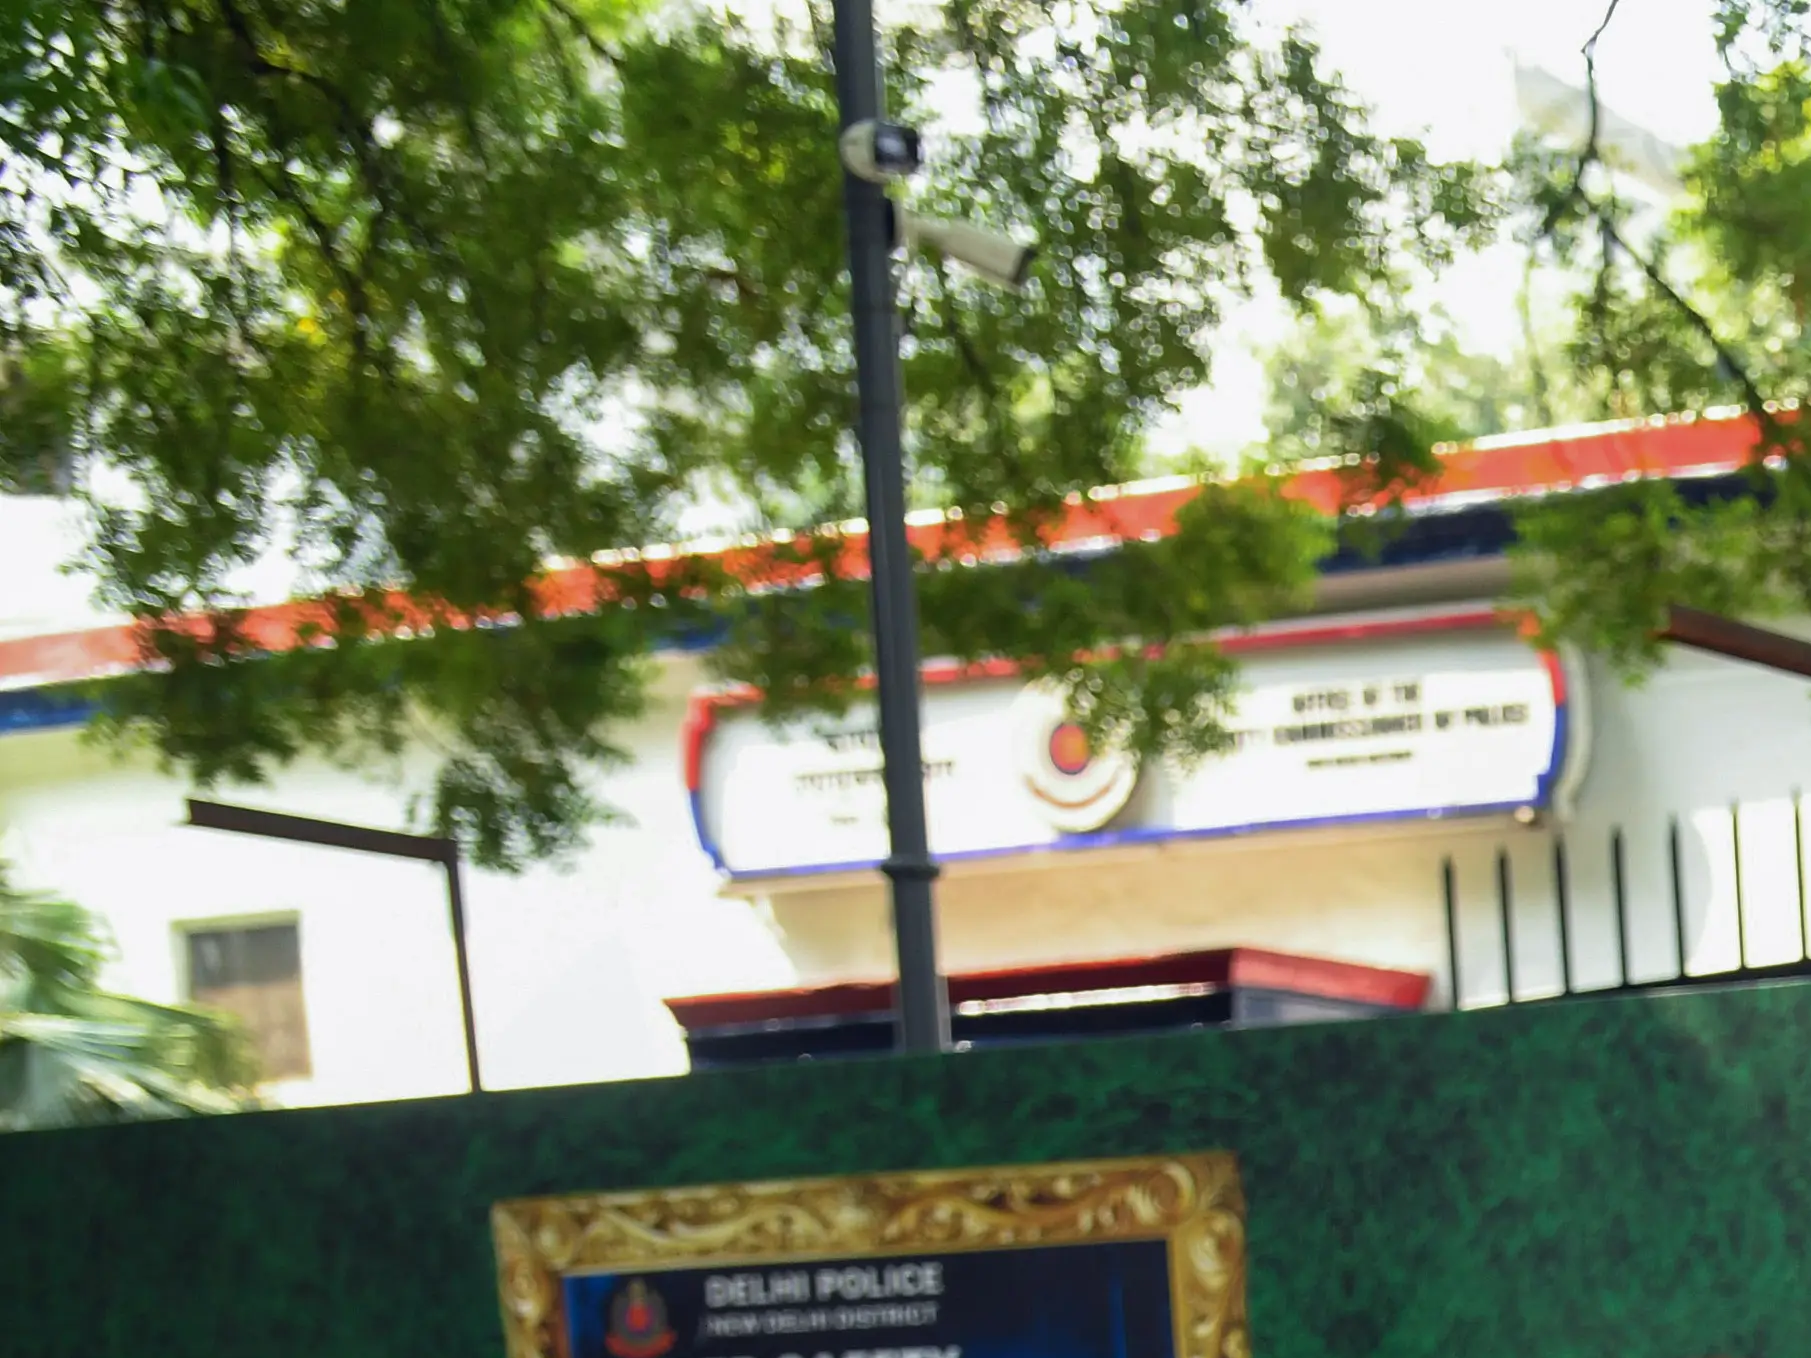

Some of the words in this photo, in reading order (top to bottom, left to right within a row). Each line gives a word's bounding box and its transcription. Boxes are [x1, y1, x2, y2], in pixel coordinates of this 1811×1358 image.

[705, 1271, 810, 1308] DELHI
[815, 1261, 945, 1300] POLICE
[705, 1311, 760, 1336] NEW
[764, 1307, 828, 1334] DELHI
[836, 1301, 938, 1331] DISTRICT
